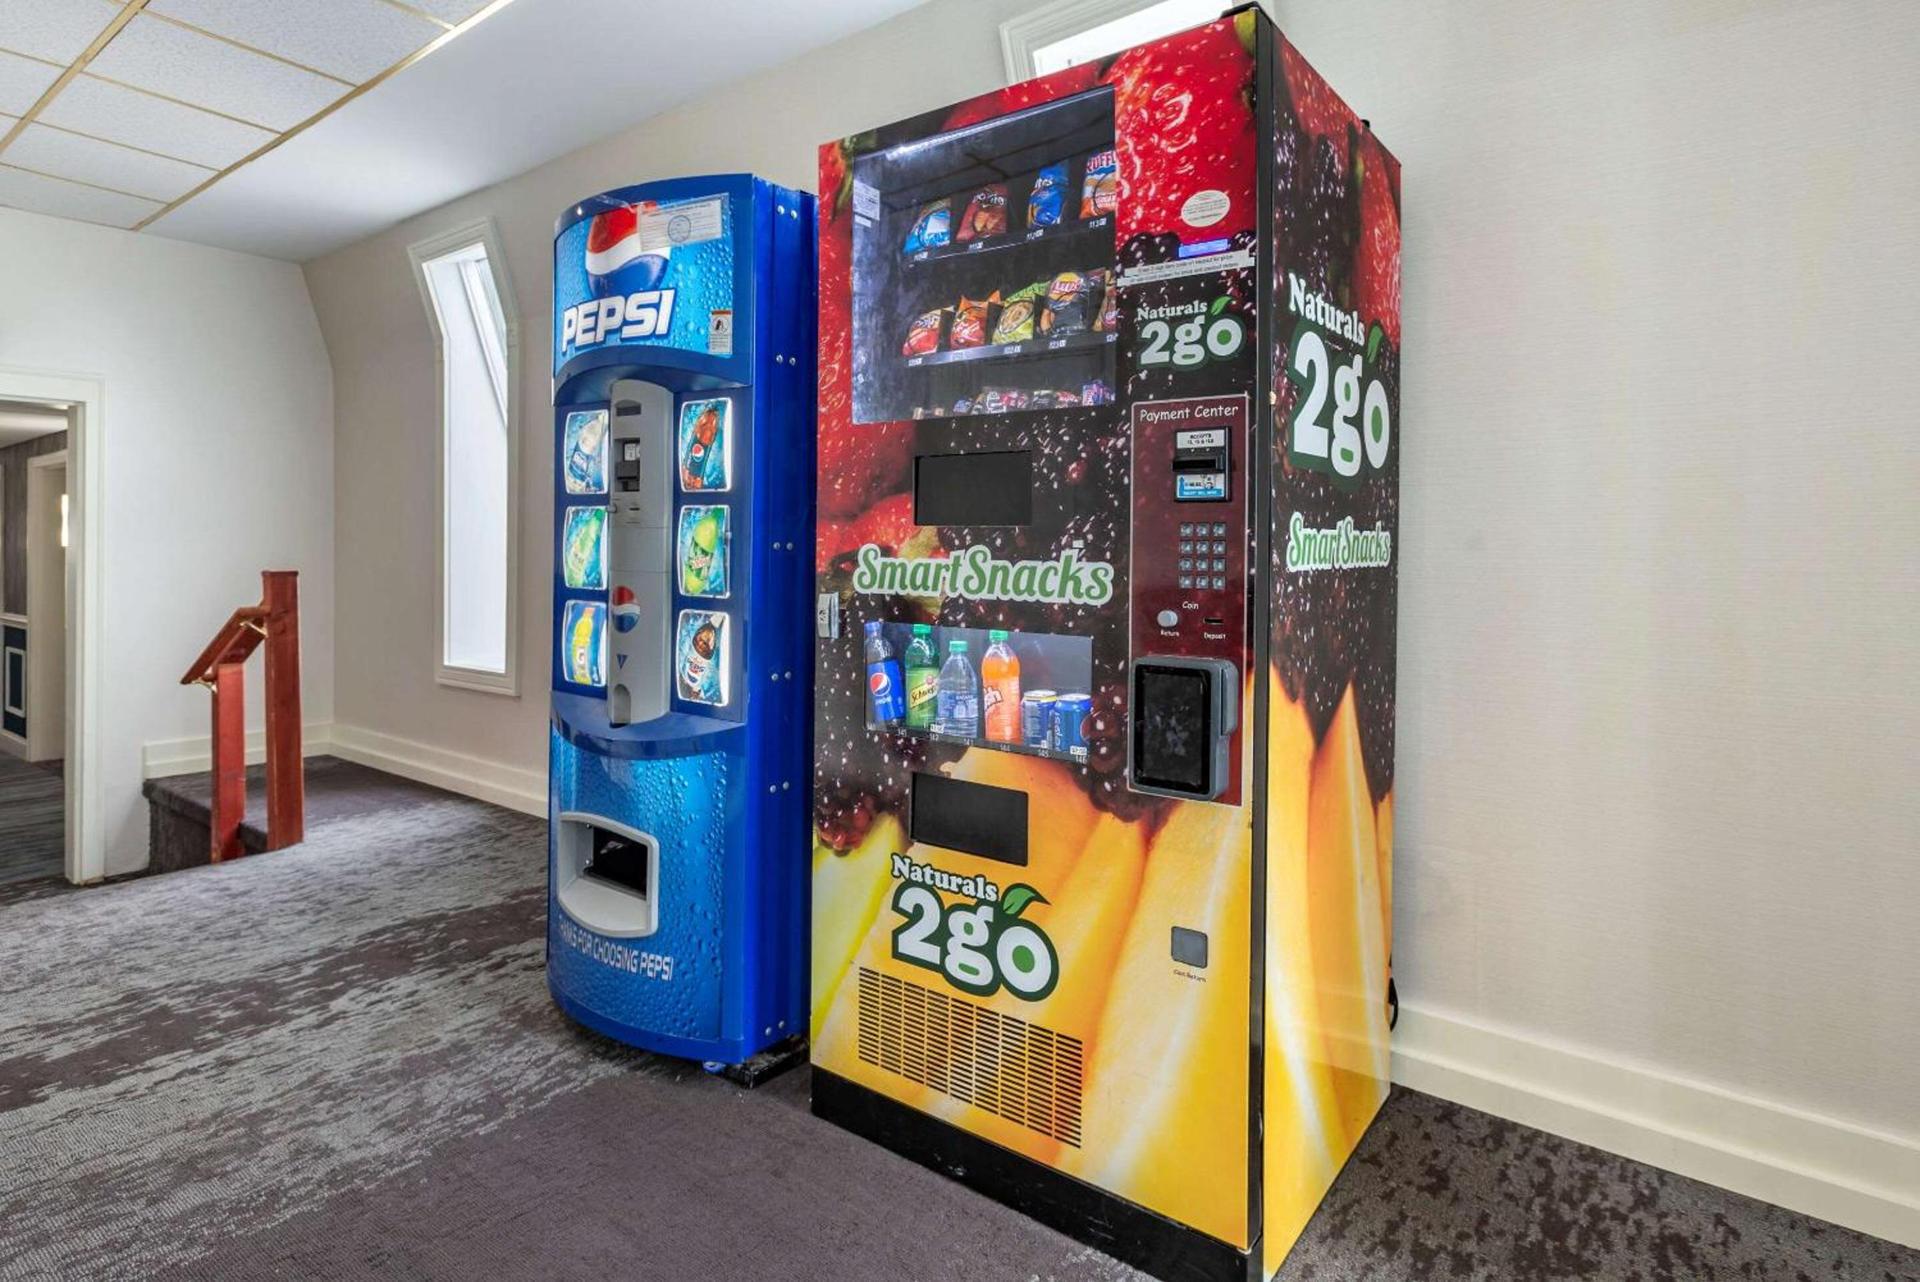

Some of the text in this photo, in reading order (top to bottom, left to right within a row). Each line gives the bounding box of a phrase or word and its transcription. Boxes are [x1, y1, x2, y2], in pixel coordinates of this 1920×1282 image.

[562, 289, 675, 352] PEPSI
[1137, 300, 1208, 320] Naturals
[1289, 272, 1365, 346] Naturals
[1141, 315, 1242, 365] 2go
[1140, 405, 1239, 424] Payment Center
[1294, 331, 1389, 477] 2go
[1288, 514, 1390, 568] SmartSnacks
[857, 547, 1110, 601] SmartSnacks
[1204, 632, 1226, 640] Deposit
[892, 854, 999, 901] Naturals
[579, 930, 593, 955] FOR
[593, 939, 639, 973] CHOOSING
[640, 952, 674, 980] PEPSI
[898, 887, 1052, 993] 2go
